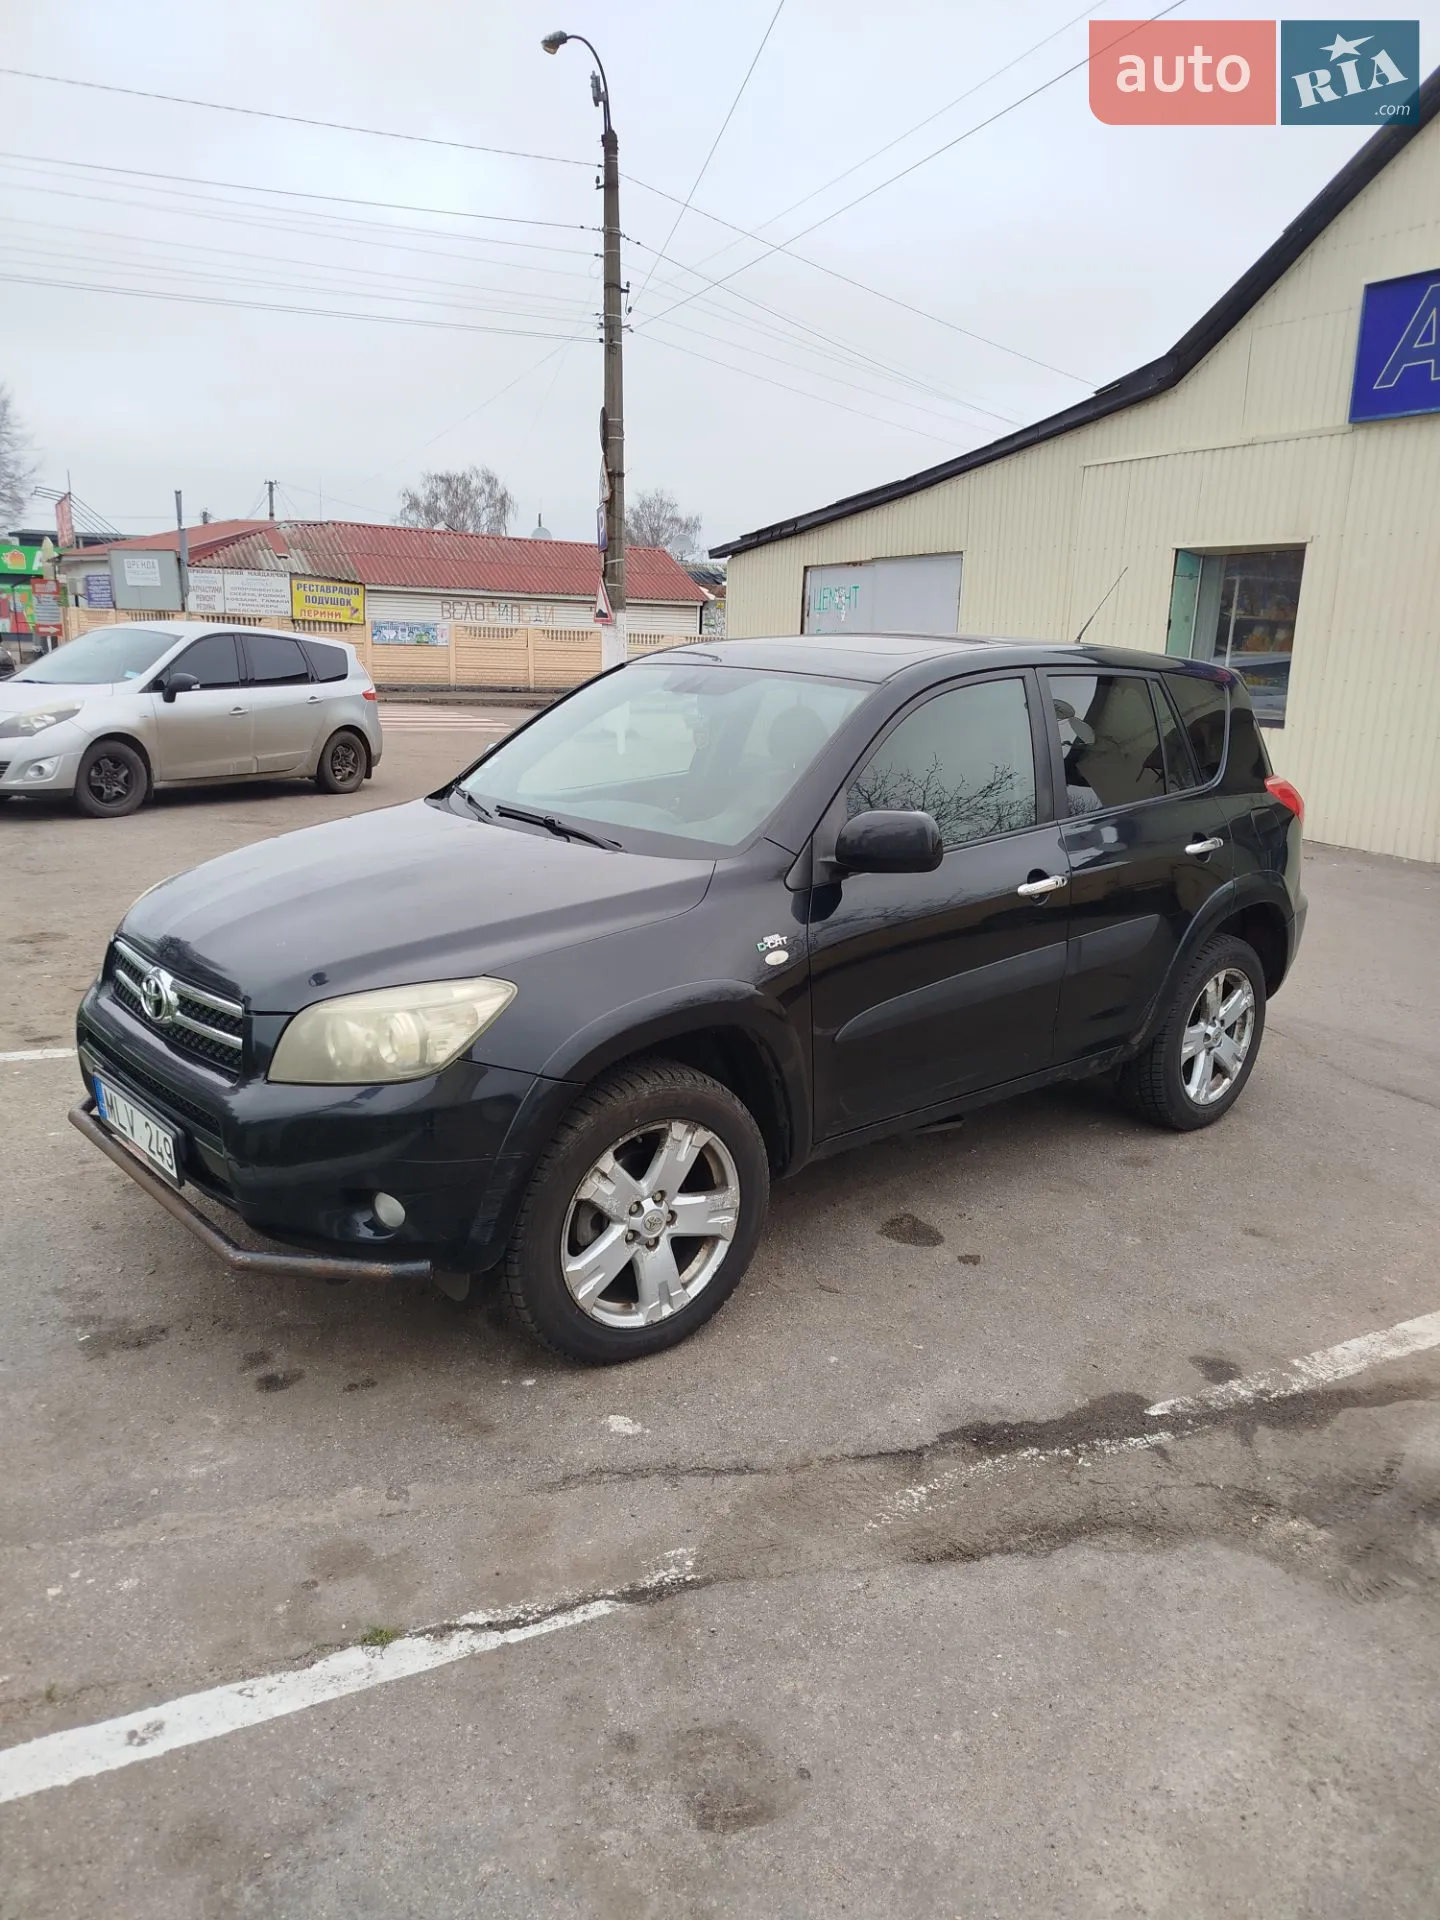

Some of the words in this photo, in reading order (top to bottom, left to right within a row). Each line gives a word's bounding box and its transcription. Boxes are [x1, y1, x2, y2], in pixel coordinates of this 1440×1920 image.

[126, 560, 156, 569] ОРЕНДА
[296, 583, 360, 596] РЕСТАВРАЦІЯ
[305, 595, 352, 606] ПОДУШОК
[300, 609, 342, 619] ПЕРИНИ
[145, 1121, 174, 1171] 249
